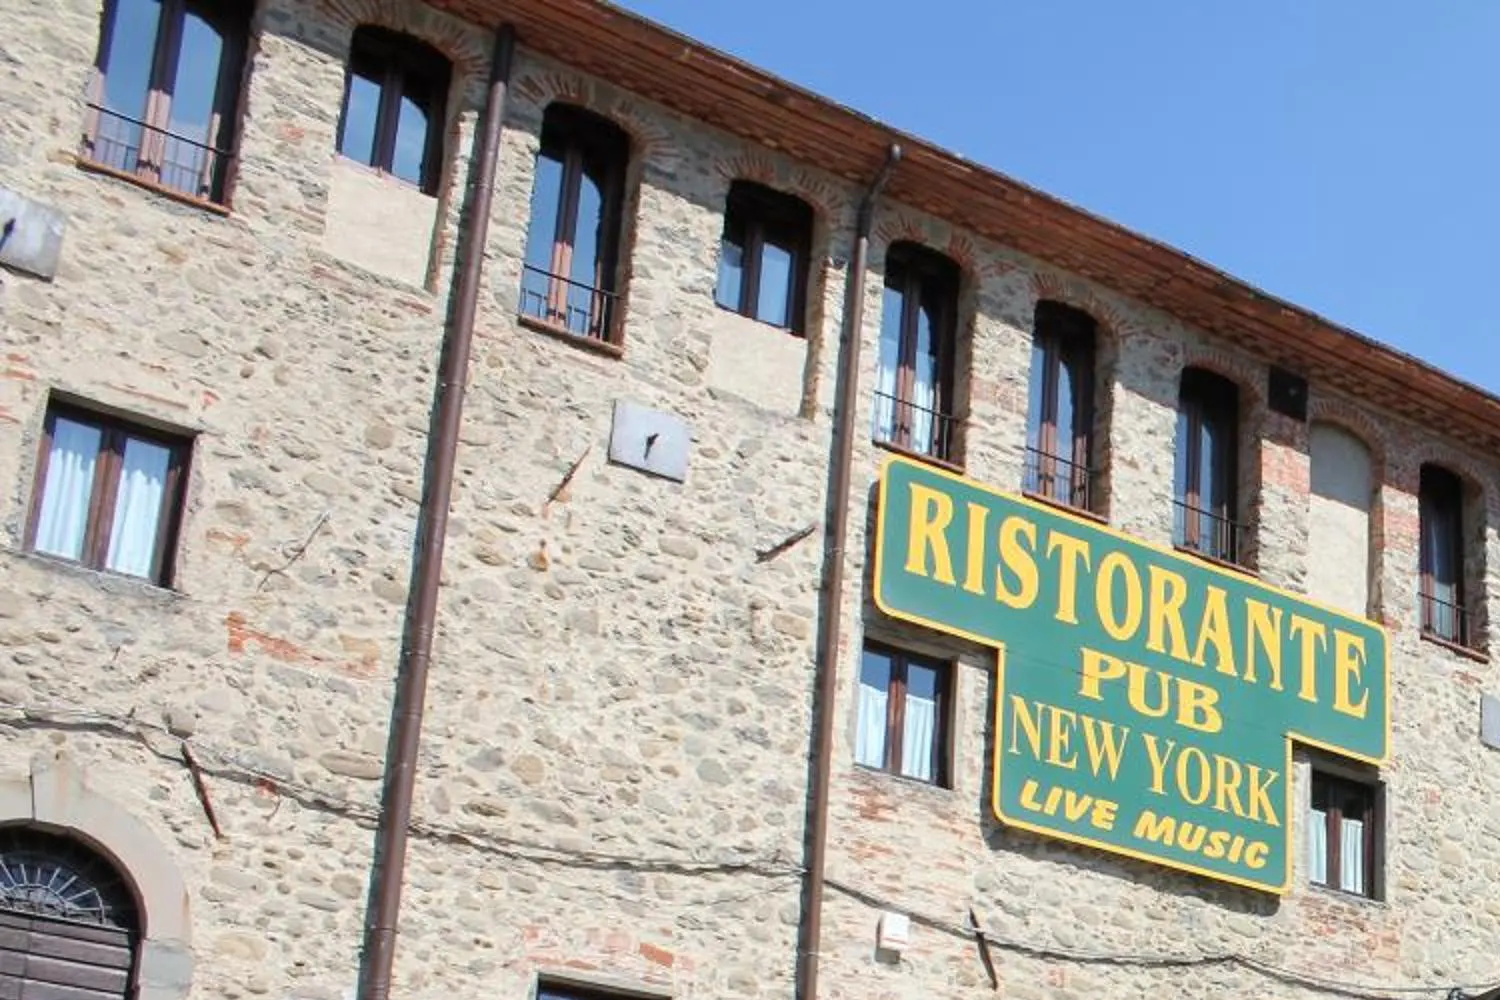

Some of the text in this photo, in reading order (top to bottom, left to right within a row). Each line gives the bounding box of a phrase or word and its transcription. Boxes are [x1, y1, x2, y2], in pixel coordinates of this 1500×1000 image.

[904, 482, 1369, 719] RISTORANTE
[1078, 646, 1224, 735] PUB
[1007, 694, 1282, 828] NEW YORK
[1018, 779, 1271, 871] LIVE MUSIC
